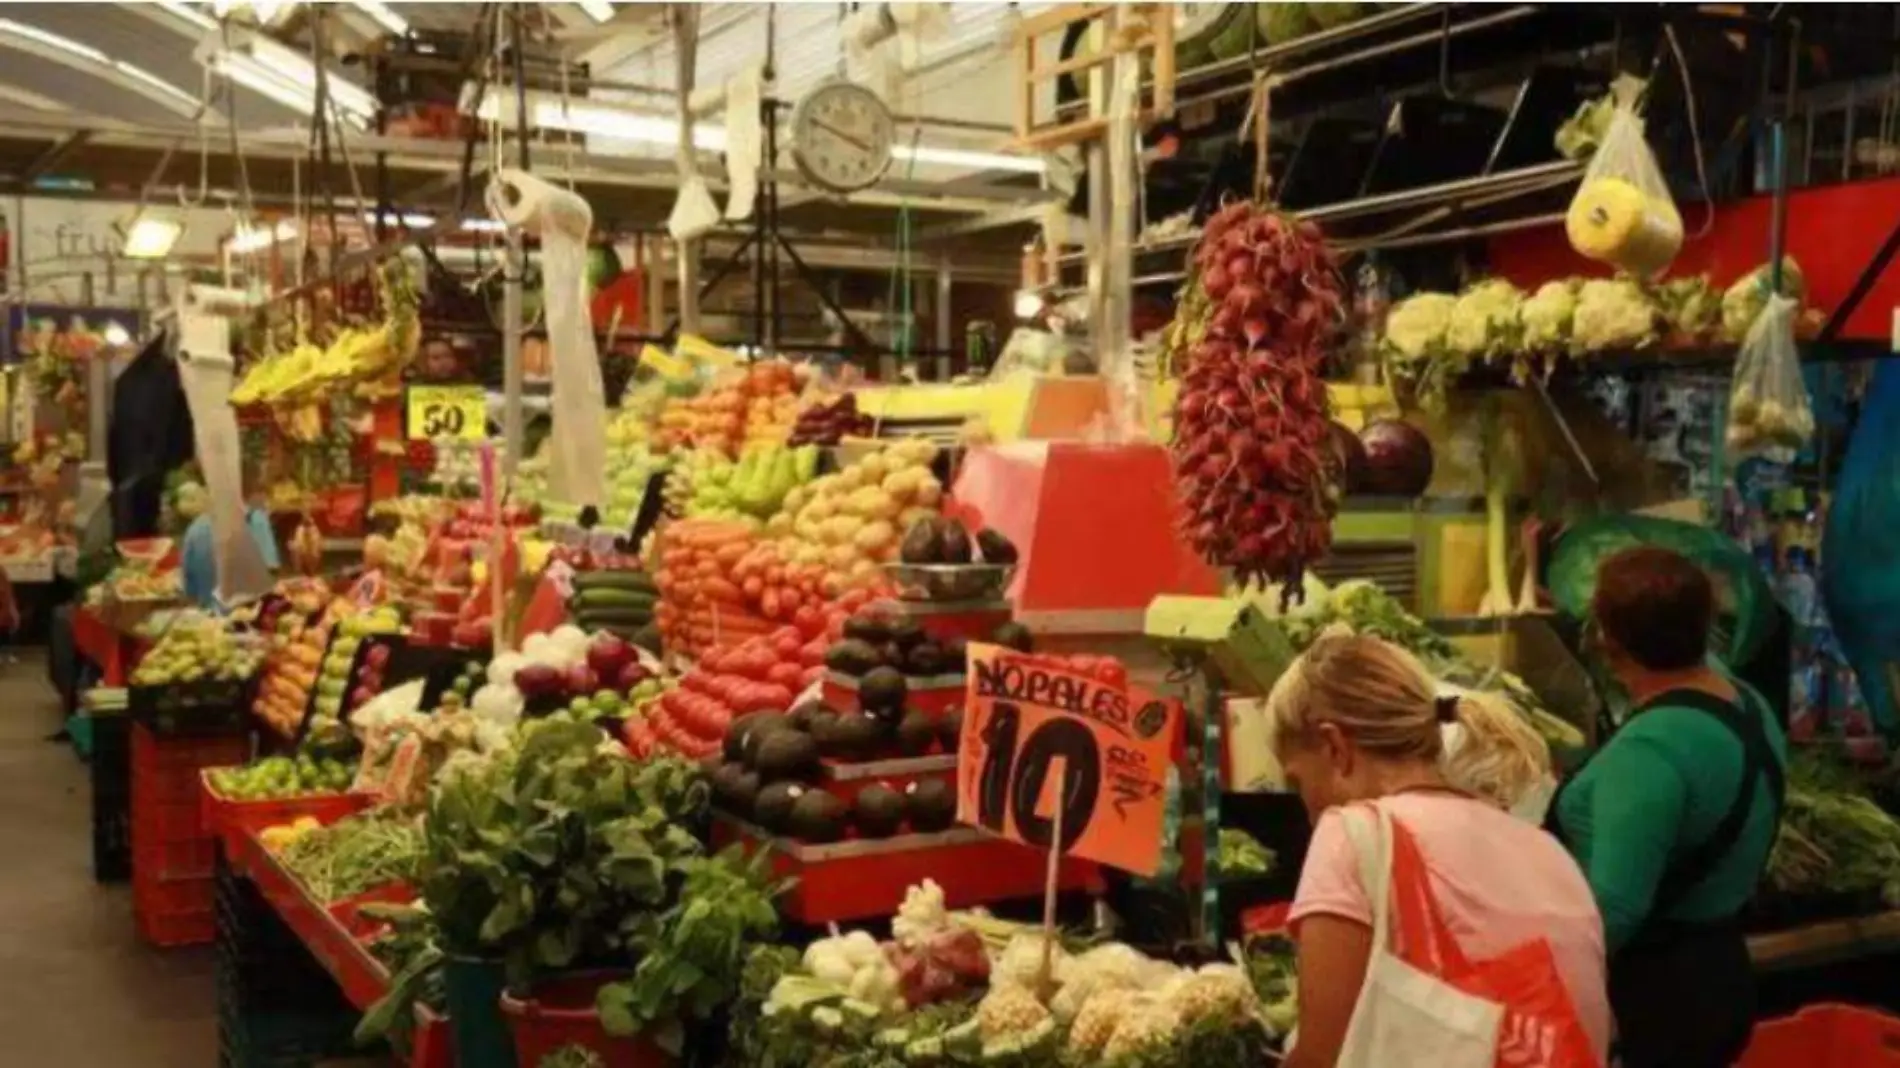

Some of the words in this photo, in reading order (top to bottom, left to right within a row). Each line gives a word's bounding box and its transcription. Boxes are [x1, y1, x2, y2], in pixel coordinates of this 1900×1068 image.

[423, 404, 465, 436] 50
[974, 656, 1130, 724] NOPALES
[978, 700, 1101, 854] 10
